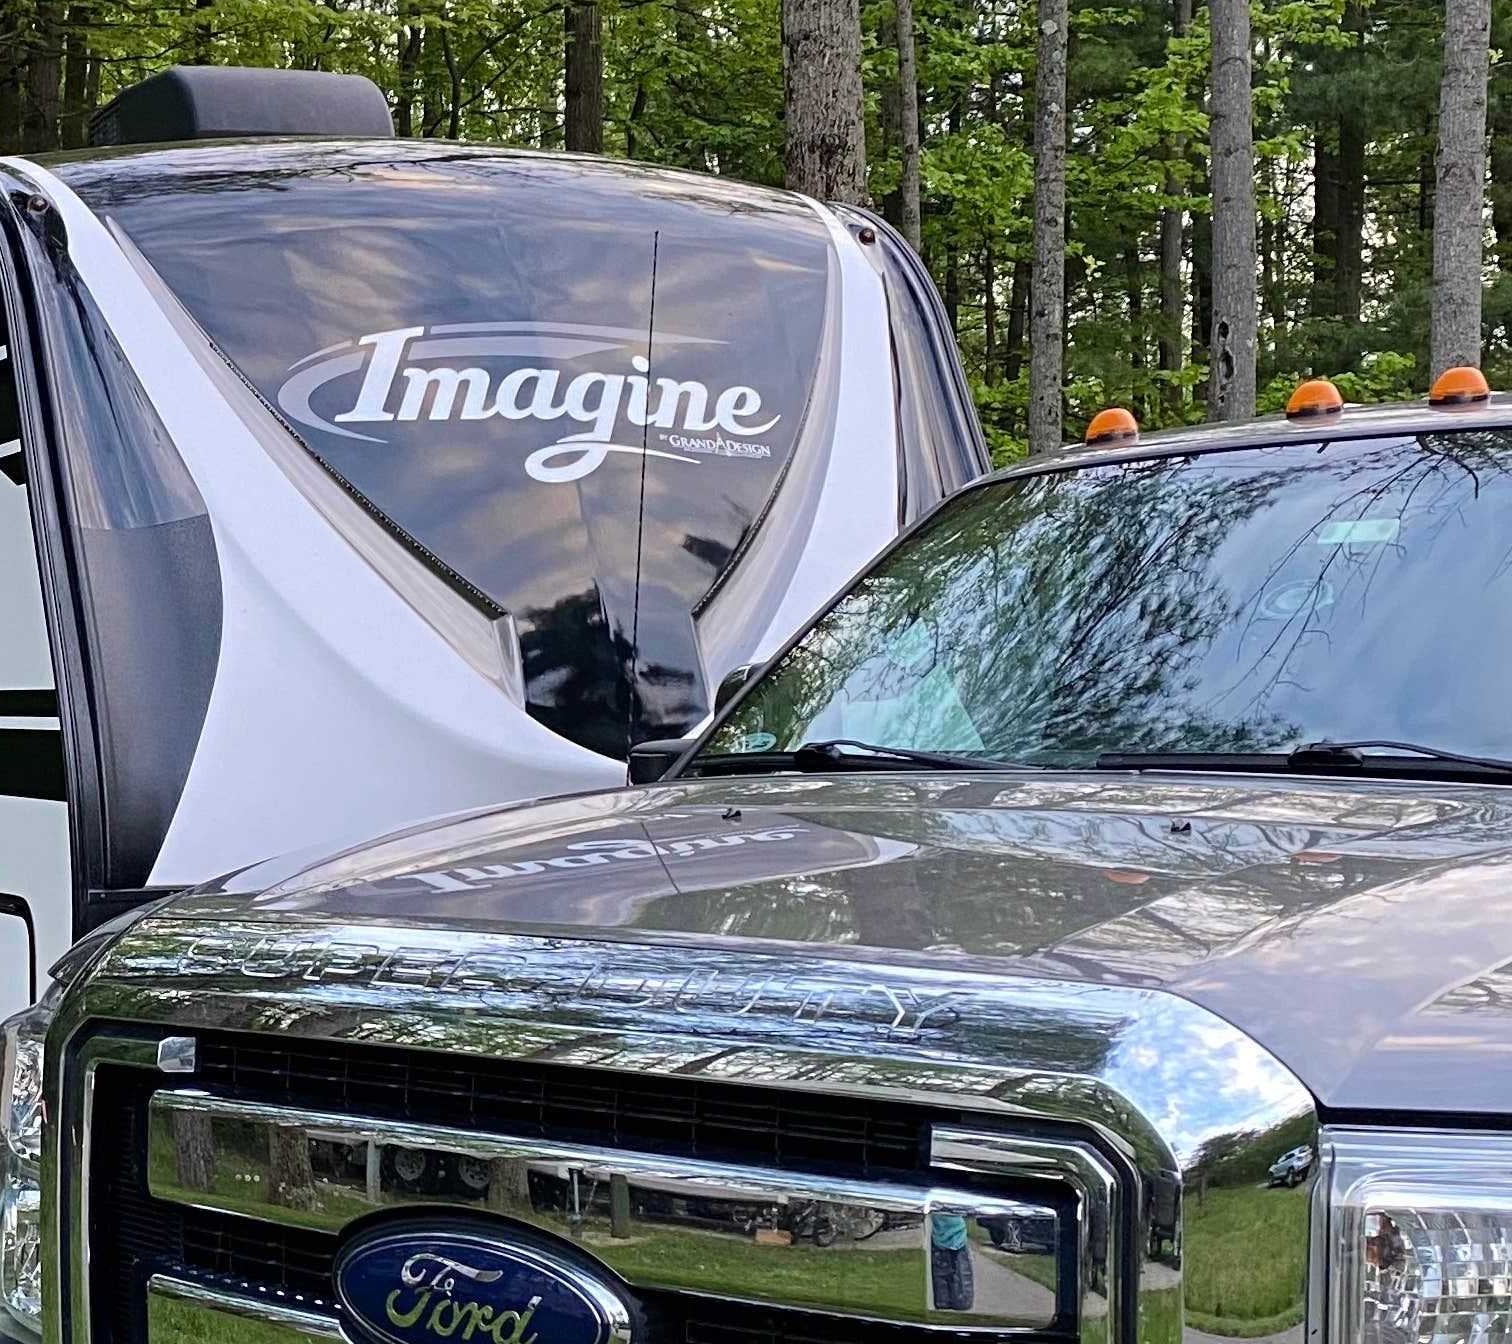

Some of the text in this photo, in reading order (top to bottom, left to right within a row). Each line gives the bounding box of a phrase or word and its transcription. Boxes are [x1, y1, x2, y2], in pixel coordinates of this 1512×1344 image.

[335, 326, 781, 483] Imagine
[669, 435, 715, 450] GRAND
[726, 440, 771, 457] DESIGN
[178, 935, 970, 1034] SUPER DUTY
